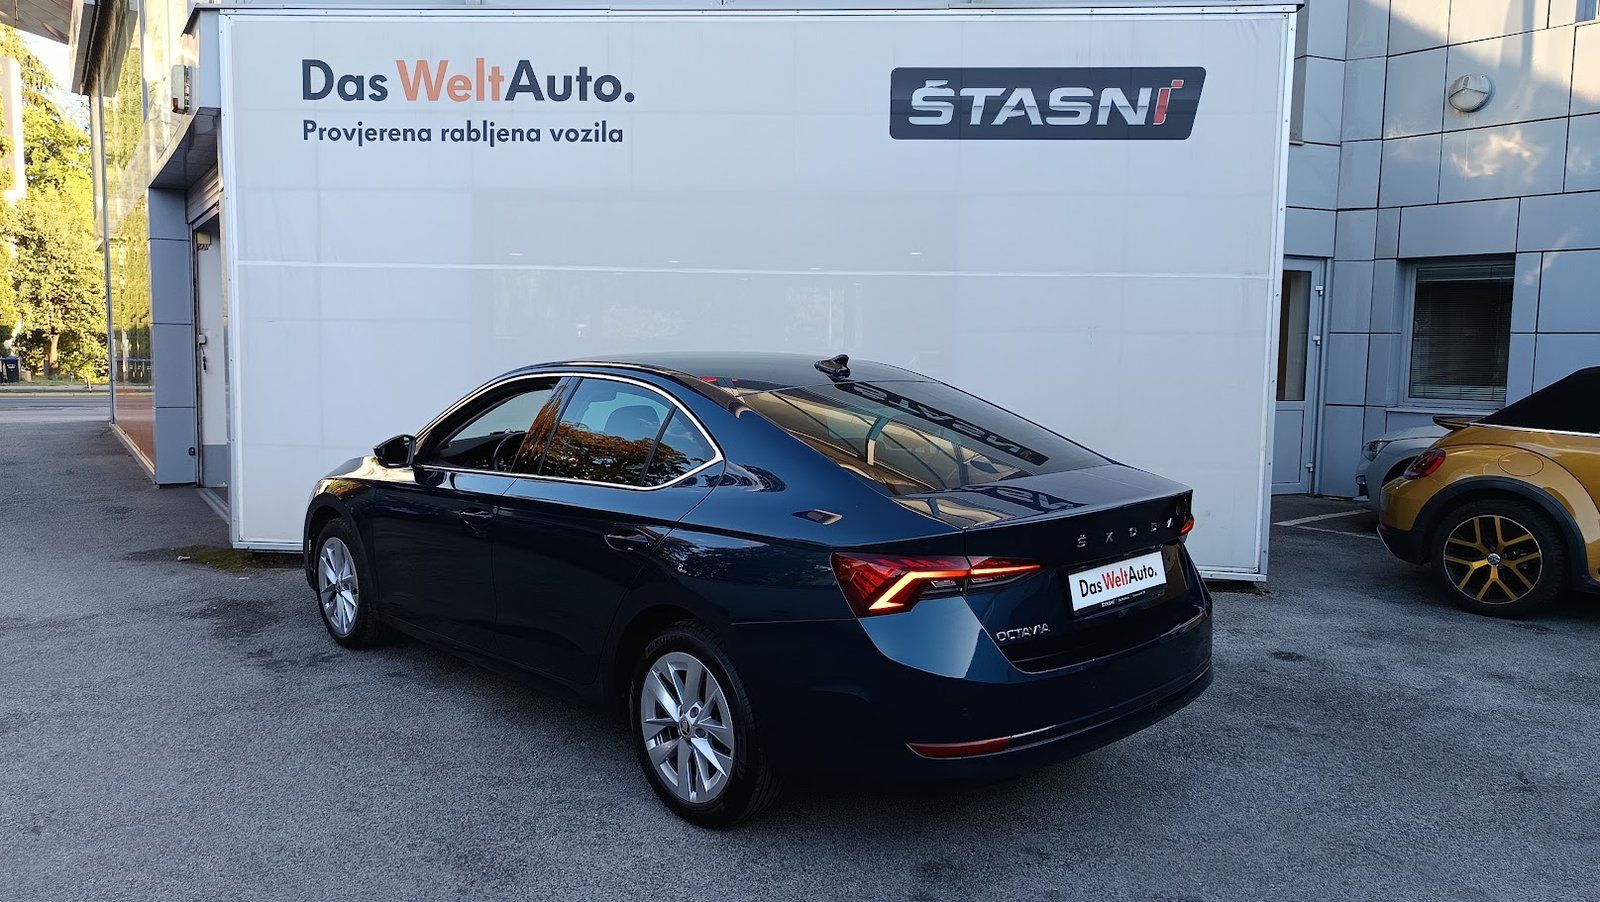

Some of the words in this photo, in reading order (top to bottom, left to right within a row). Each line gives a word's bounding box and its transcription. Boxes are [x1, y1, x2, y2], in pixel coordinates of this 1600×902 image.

[301, 59, 388, 102] Das
[397, 58, 635, 102] WeltAuto.
[303, 119, 432, 147] Provjerena
[441, 119, 541, 147] rabljena
[549, 120, 624, 143] vozila
[1079, 578, 1103, 598] Das
[1102, 565, 1157, 590] WeltAuto.
[996, 623, 1051, 642] OCTAVIA
